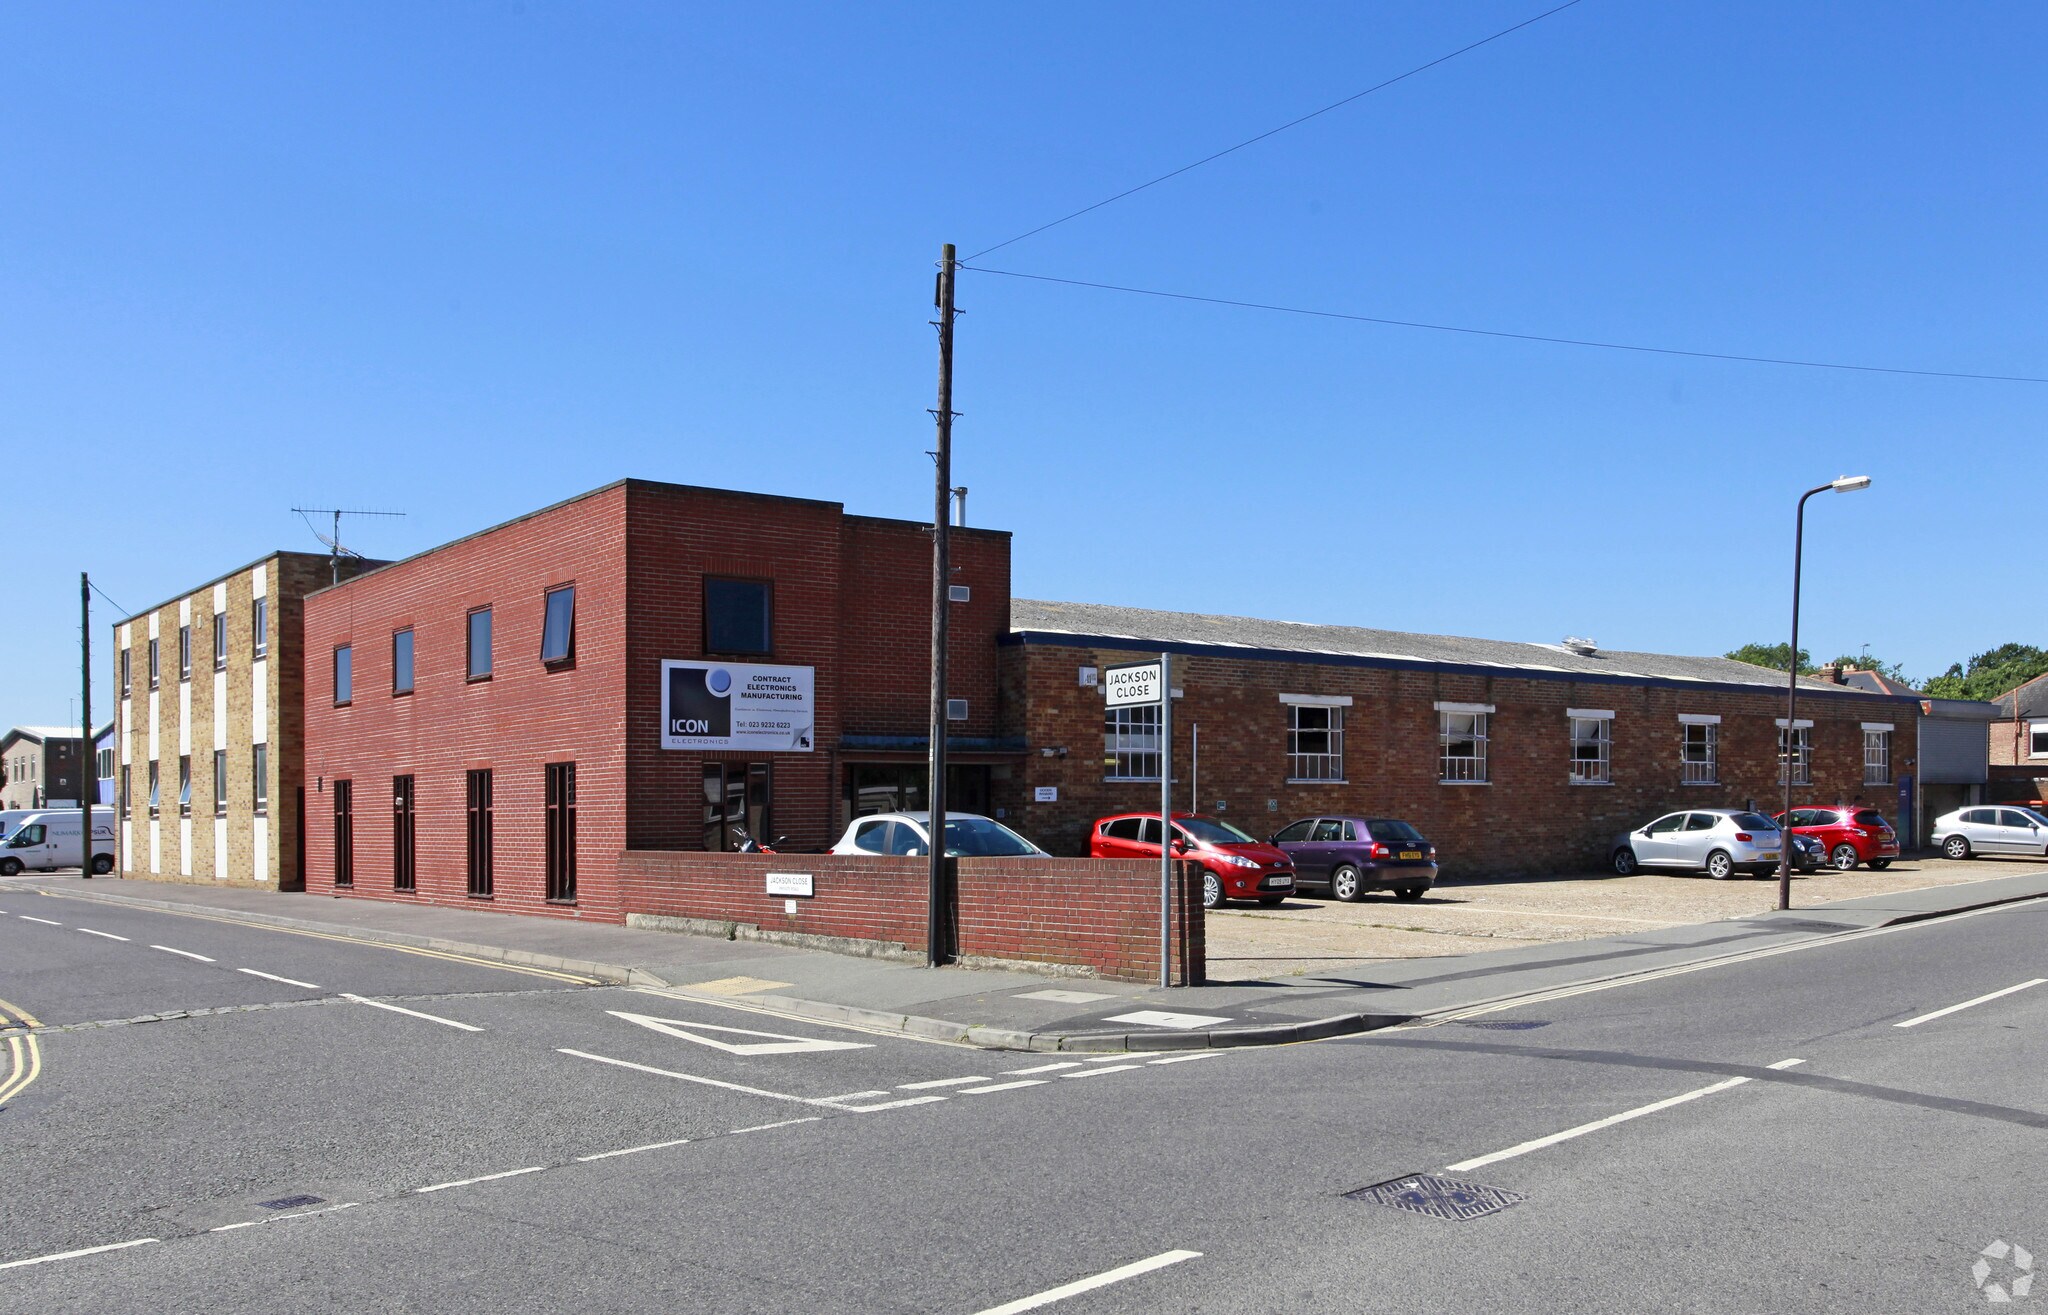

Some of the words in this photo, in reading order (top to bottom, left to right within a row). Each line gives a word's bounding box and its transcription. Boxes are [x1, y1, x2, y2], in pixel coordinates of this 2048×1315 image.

[752, 675, 791, 683] CONTRACT
[1109, 670, 1156, 685] JACKSON
[741, 692, 803, 700] MANUFACTURING
[1116, 685, 1149, 698] CLOSE
[672, 719, 709, 733] ICON
[761, 721, 775, 729] 9232
[770, 876, 791, 885] JACKSON
[792, 877, 808, 885] CLOSE
